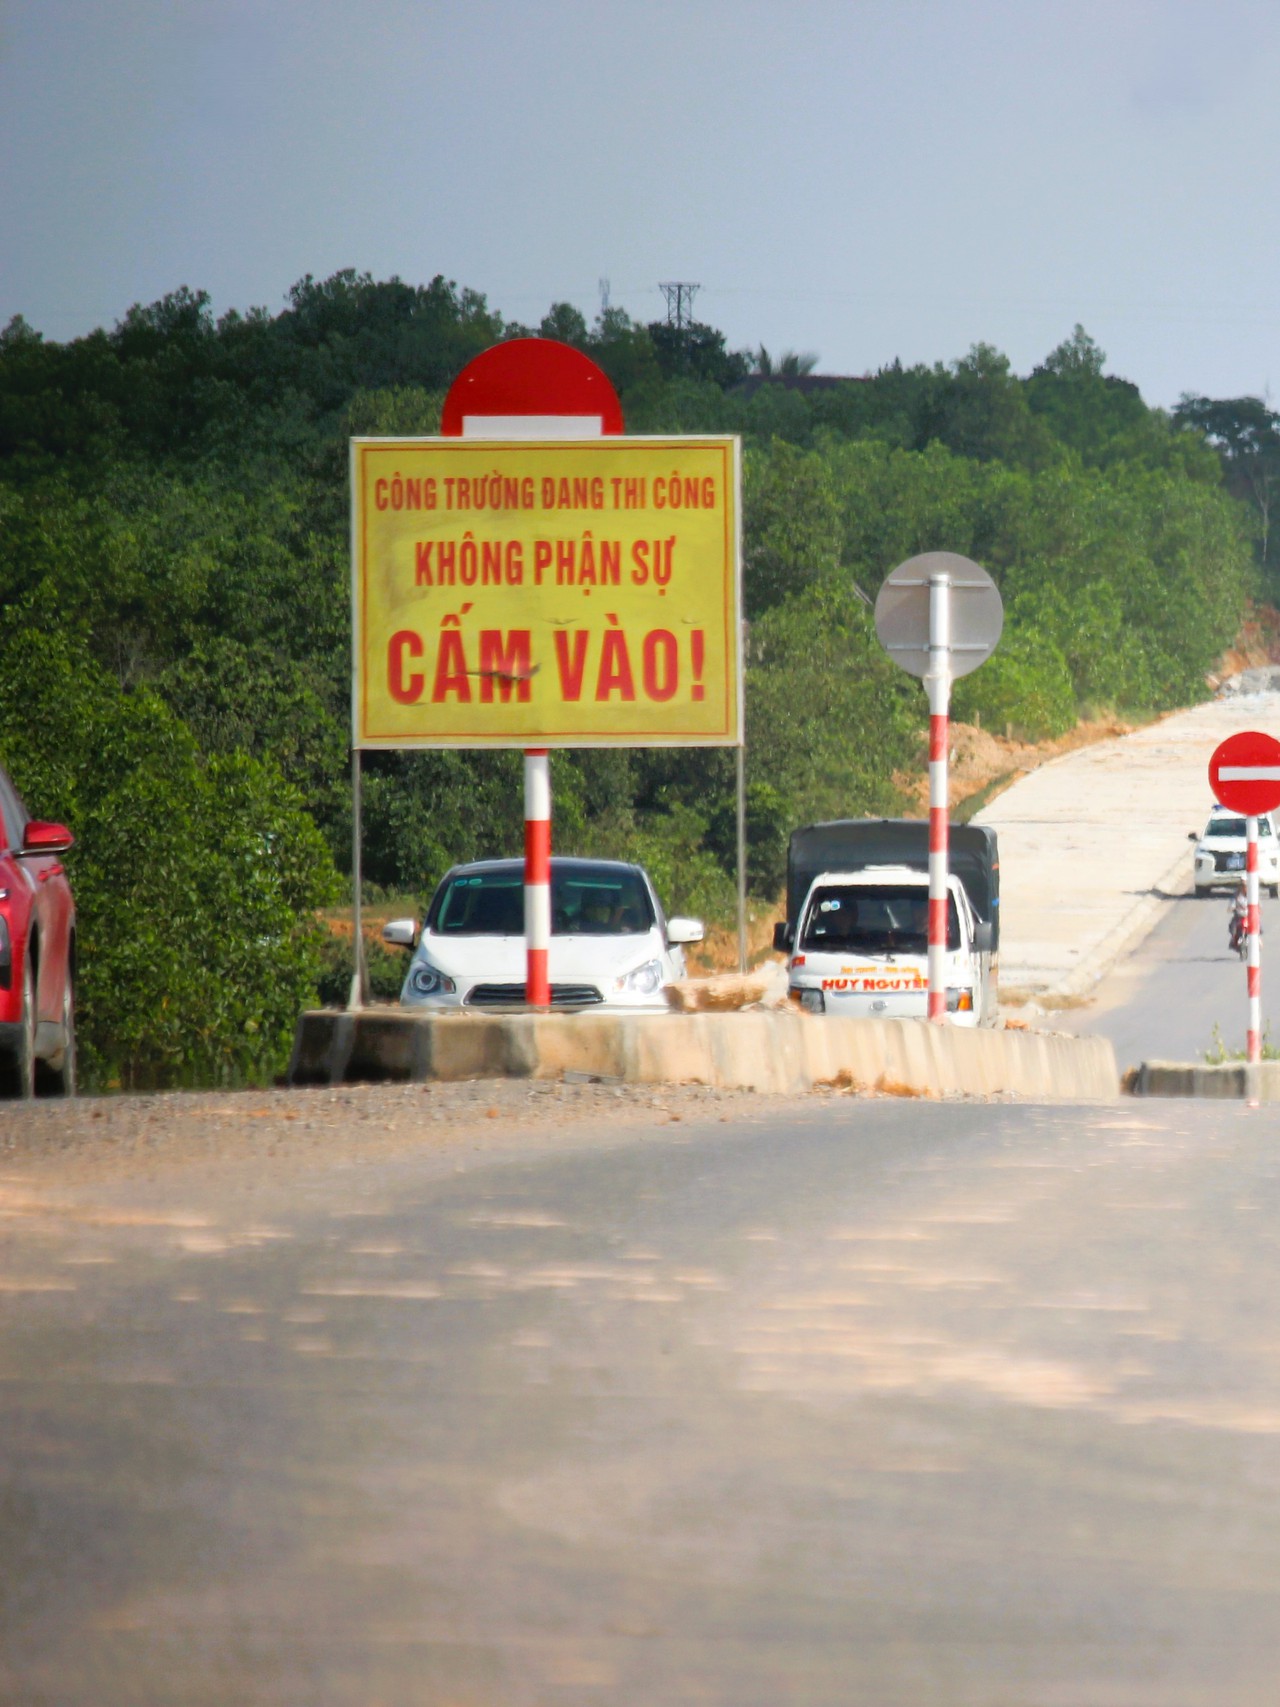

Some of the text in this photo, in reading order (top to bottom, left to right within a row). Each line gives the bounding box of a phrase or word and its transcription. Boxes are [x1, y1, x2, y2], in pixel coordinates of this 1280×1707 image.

[375, 469, 715, 511] CÔNG TRƯỜNG ĐANG THI CÔNG
[414, 530, 676, 596] KHÔNG PHẬN SỰ
[387, 603, 705, 705] CẤM VÀO!
[821, 978, 859, 991] HUY
